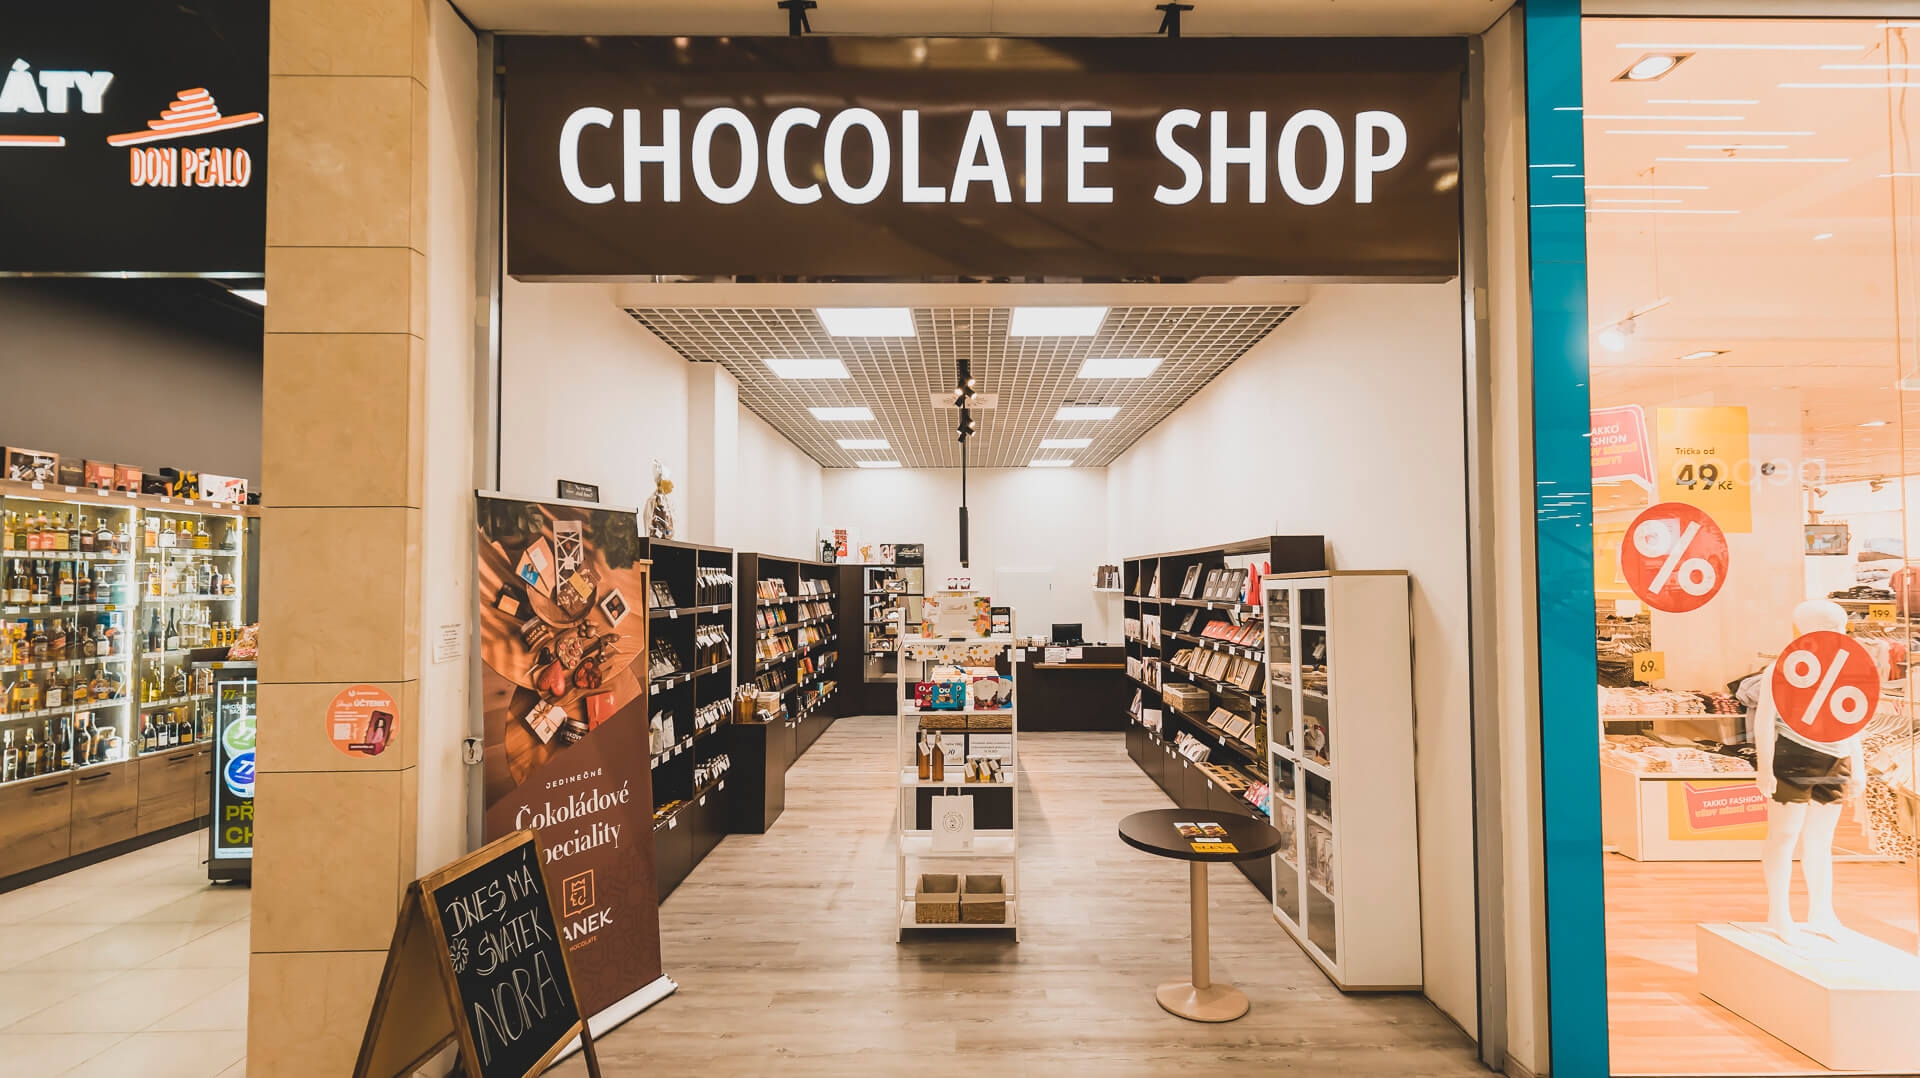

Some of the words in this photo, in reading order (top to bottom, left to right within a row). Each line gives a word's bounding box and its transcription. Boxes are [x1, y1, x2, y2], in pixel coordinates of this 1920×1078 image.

[130, 147, 177, 188] DON
[181, 147, 252, 188] PEALO
[558, 107, 1114, 205] CHOCOLATE
[1154, 108, 1408, 206] SHOP
[1675, 447, 1701, 455] Trička
[1703, 447, 1715, 455] od
[1676, 463, 1718, 490] 49
[1718, 480, 1733, 490] Kč
[545, 767, 602, 789] JEDINEČNÉ
[515, 780, 629, 831] Čokoládové
[445, 879, 507, 937] DNES
[507, 848, 539, 902] MÁ
[476, 907, 552, 976] SVÁTEK
[475, 950, 565, 1067] NORA
